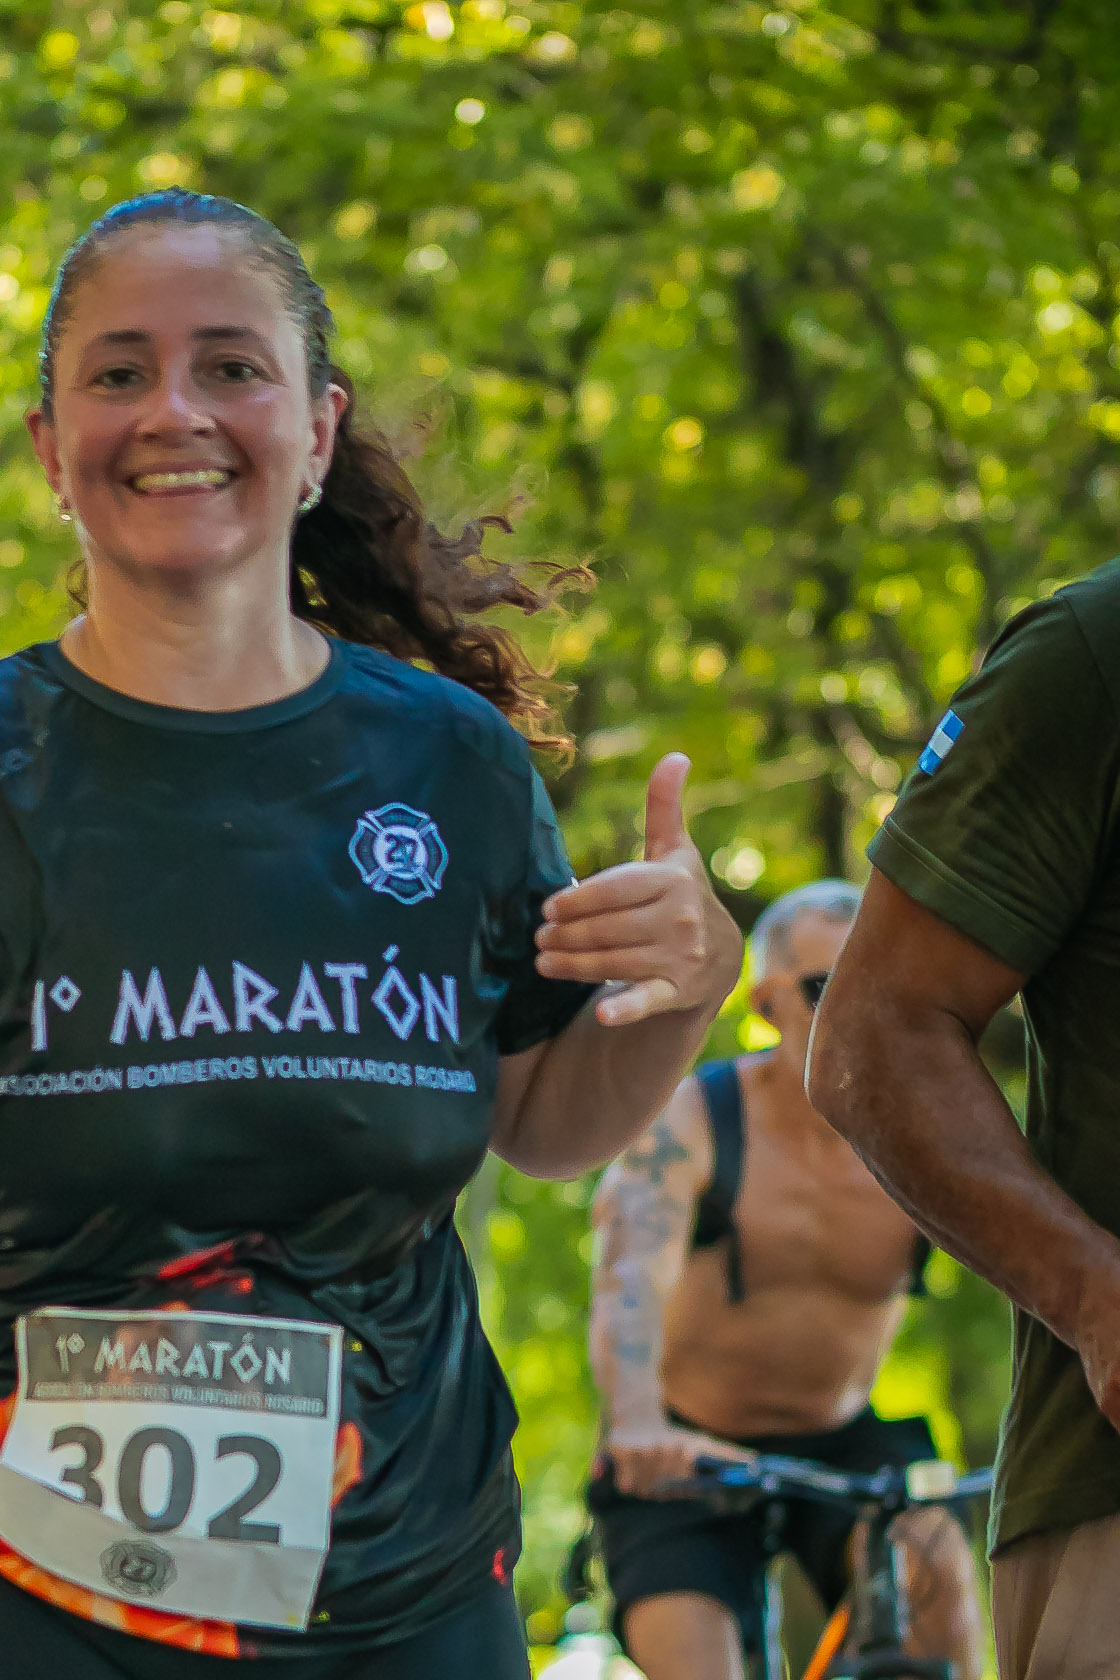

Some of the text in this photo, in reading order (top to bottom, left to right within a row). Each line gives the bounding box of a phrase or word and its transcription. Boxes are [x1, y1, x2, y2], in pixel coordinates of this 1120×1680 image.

[109, 943, 461, 1045] MARATÓN
[127, 1055, 258, 1090] BOMBEROS
[262, 1054, 412, 1088] VOLUNTARIOS
[55, 1331, 291, 1385] 1° MARATÓN
[48, 1423, 282, 1545] 302
